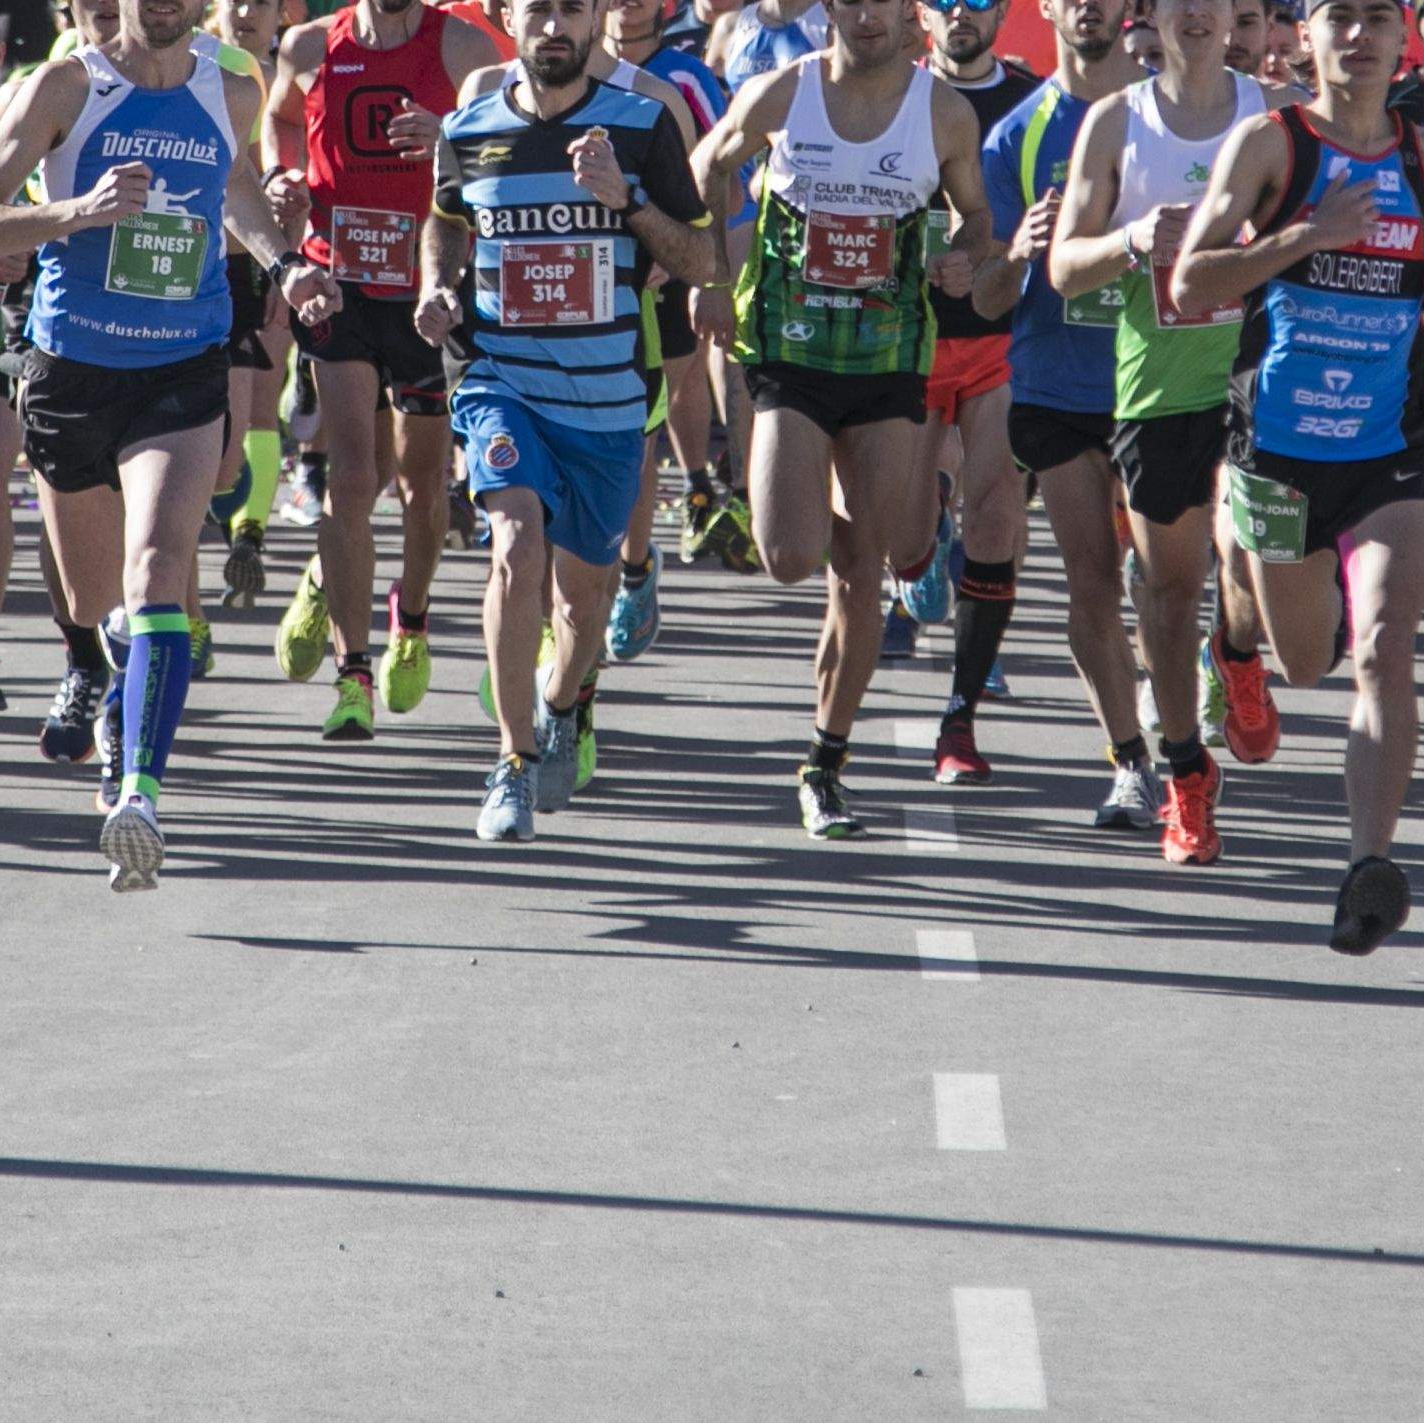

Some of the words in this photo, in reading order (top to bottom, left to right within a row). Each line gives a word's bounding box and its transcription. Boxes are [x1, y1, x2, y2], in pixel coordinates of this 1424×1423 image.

[815, 182, 856, 194] CLUB
[852, 196, 874, 206] DEL
[133, 233, 195, 253] ERNEST
[347, 228, 379, 243] JOSE
[827, 233, 877, 247] MARC
[359, 246, 388, 263] 321
[599, 246, 609, 267] 314
[833, 251, 869, 267] 324
[152, 256, 172, 275] 18
[523, 265, 575, 280] JOSEP
[1309, 252, 1404, 294] SOLERGIBERT
[532, 285, 567, 302] 314
[68, 313, 198, 339] www.duscholux.es
[1294, 333, 1368, 350] ARGON
[1248, 516, 1267, 537] 19
